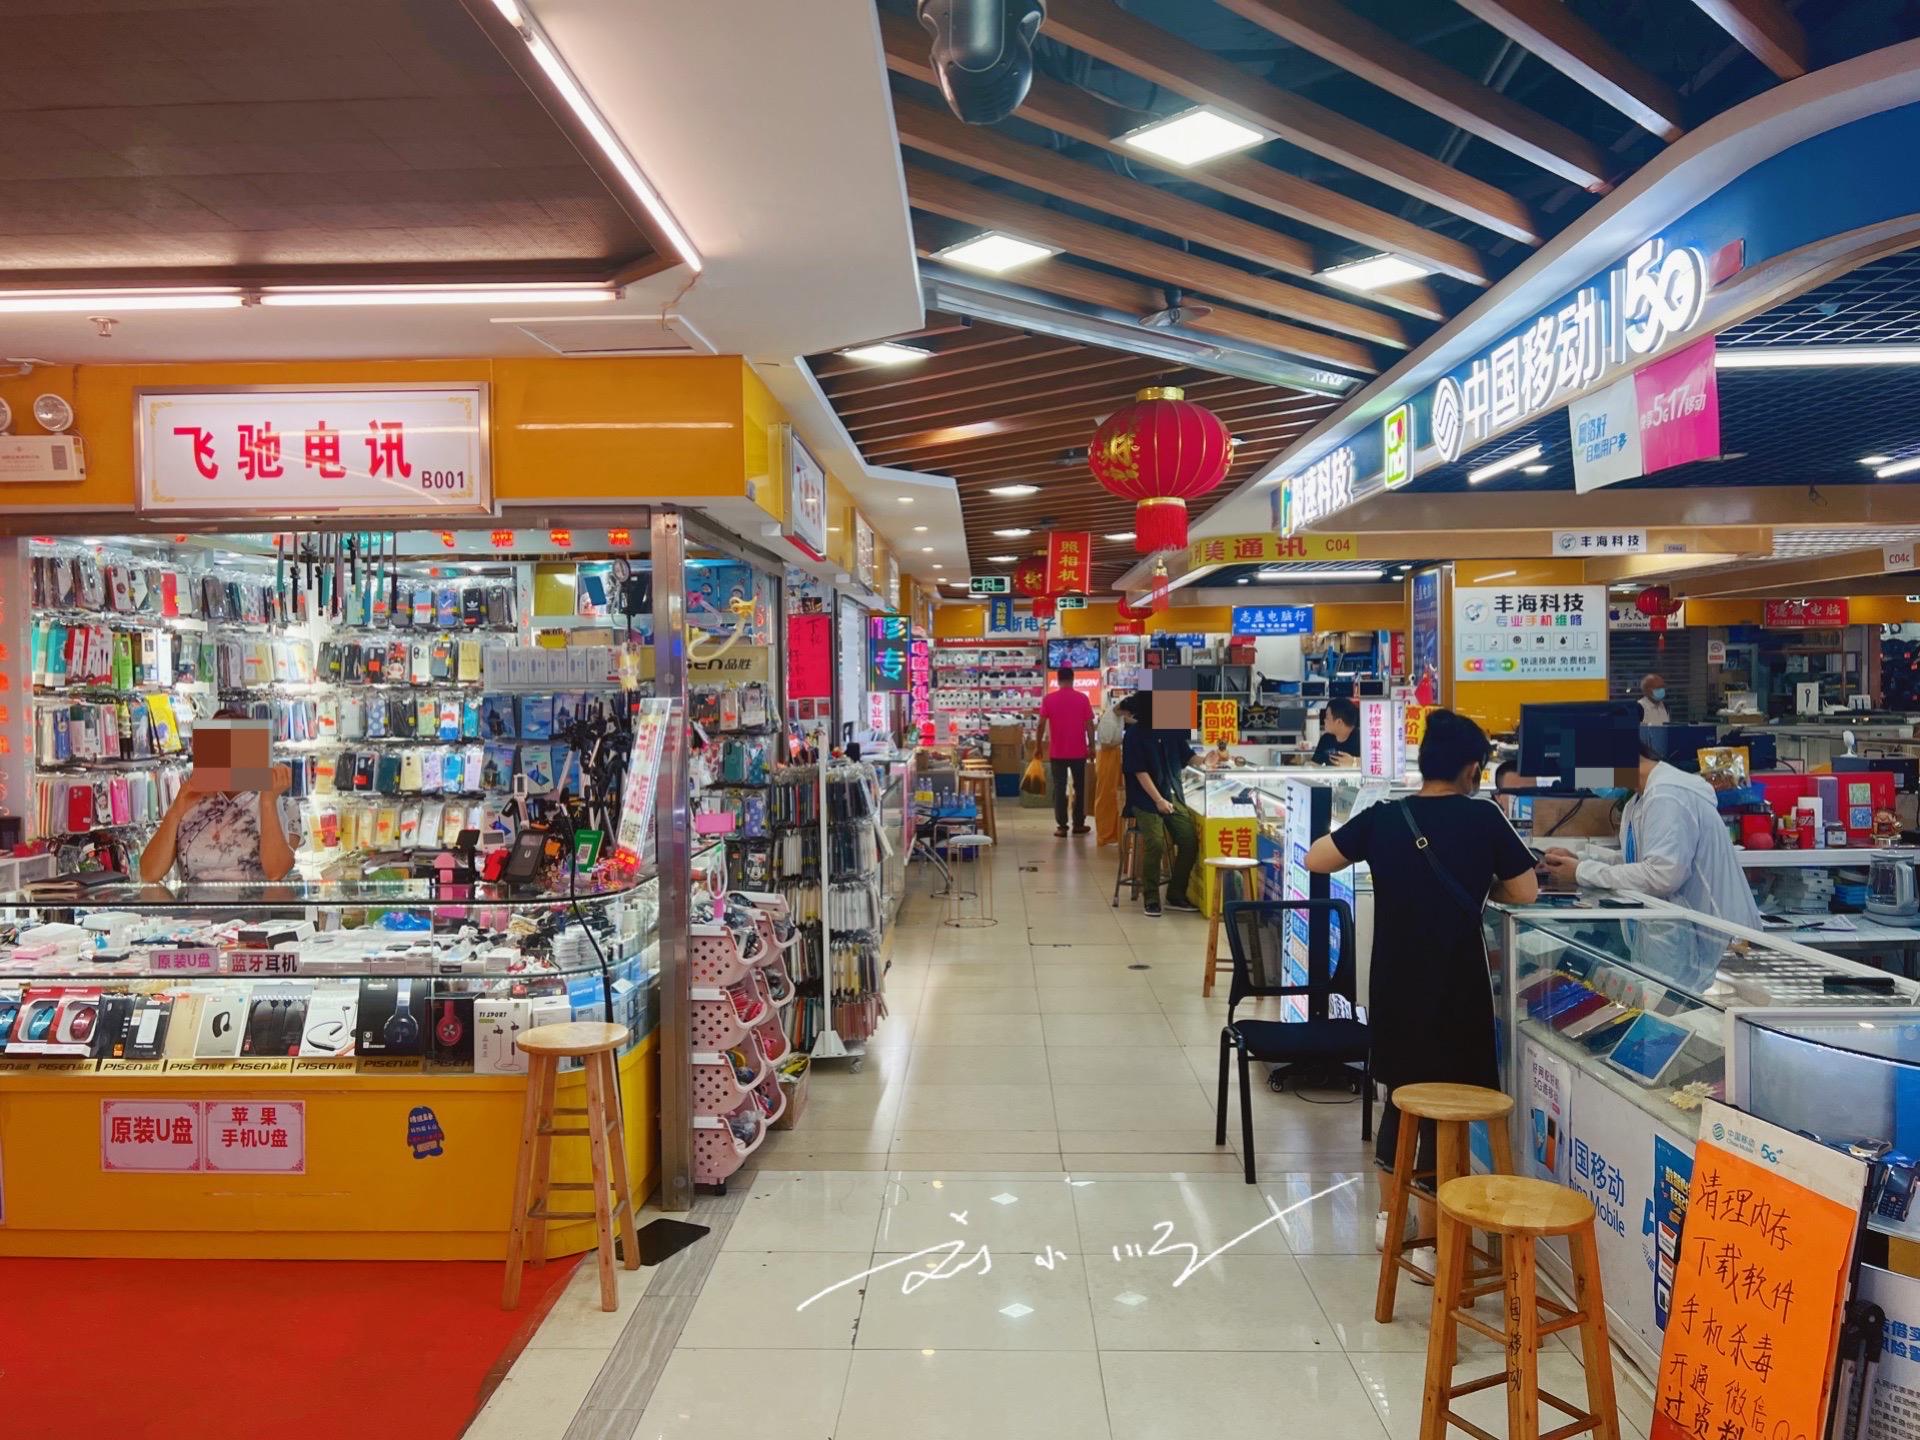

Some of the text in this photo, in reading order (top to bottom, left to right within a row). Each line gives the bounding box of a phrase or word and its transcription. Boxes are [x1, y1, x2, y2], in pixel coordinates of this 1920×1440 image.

[1626, 238, 1706, 353] 5G
[1464, 287, 1602, 438] 中国移动
[173, 419, 412, 480] 飞驰电讯
[421, 470, 465, 490] B001
[1325, 539, 1350, 551] C04
[1580, 535, 1640, 548] 丰海科技
[1060, 540, 1080, 582] 照相机
[1889, 553, 1910, 564] C04c
[1494, 593, 1584, 613] 丰海科技
[1496, 614, 1582, 627] 专业手机维修
[1560, 656, 1597, 665] 免费检测
[1204, 702, 1235, 715] 高价
[1204, 717, 1235, 729] 回收
[1204, 731, 1236, 744] 手机
[1369, 703, 1383, 775] 精修苹果主板
[157, 952, 211, 969] 原装U盘
[231, 953, 298, 973] 蓝牙耳机
[232, 1107, 278, 1125] 苹果
[111, 1117, 193, 1145] 原装U盘
[221, 1129, 288, 1148] 手机U盘
[1761, 1144, 1777, 1163] 5G
[1569, 1137, 1625, 1207] 国移动
[1590, 1190, 1625, 1238] Mobile
[1695, 1168, 1793, 1250] 清理内存
[1693, 1236, 1795, 1325] 下载软件
[1506, 1271, 1523, 1394] 中国移动
[1680, 1296, 1775, 1384] 手机杀毒
